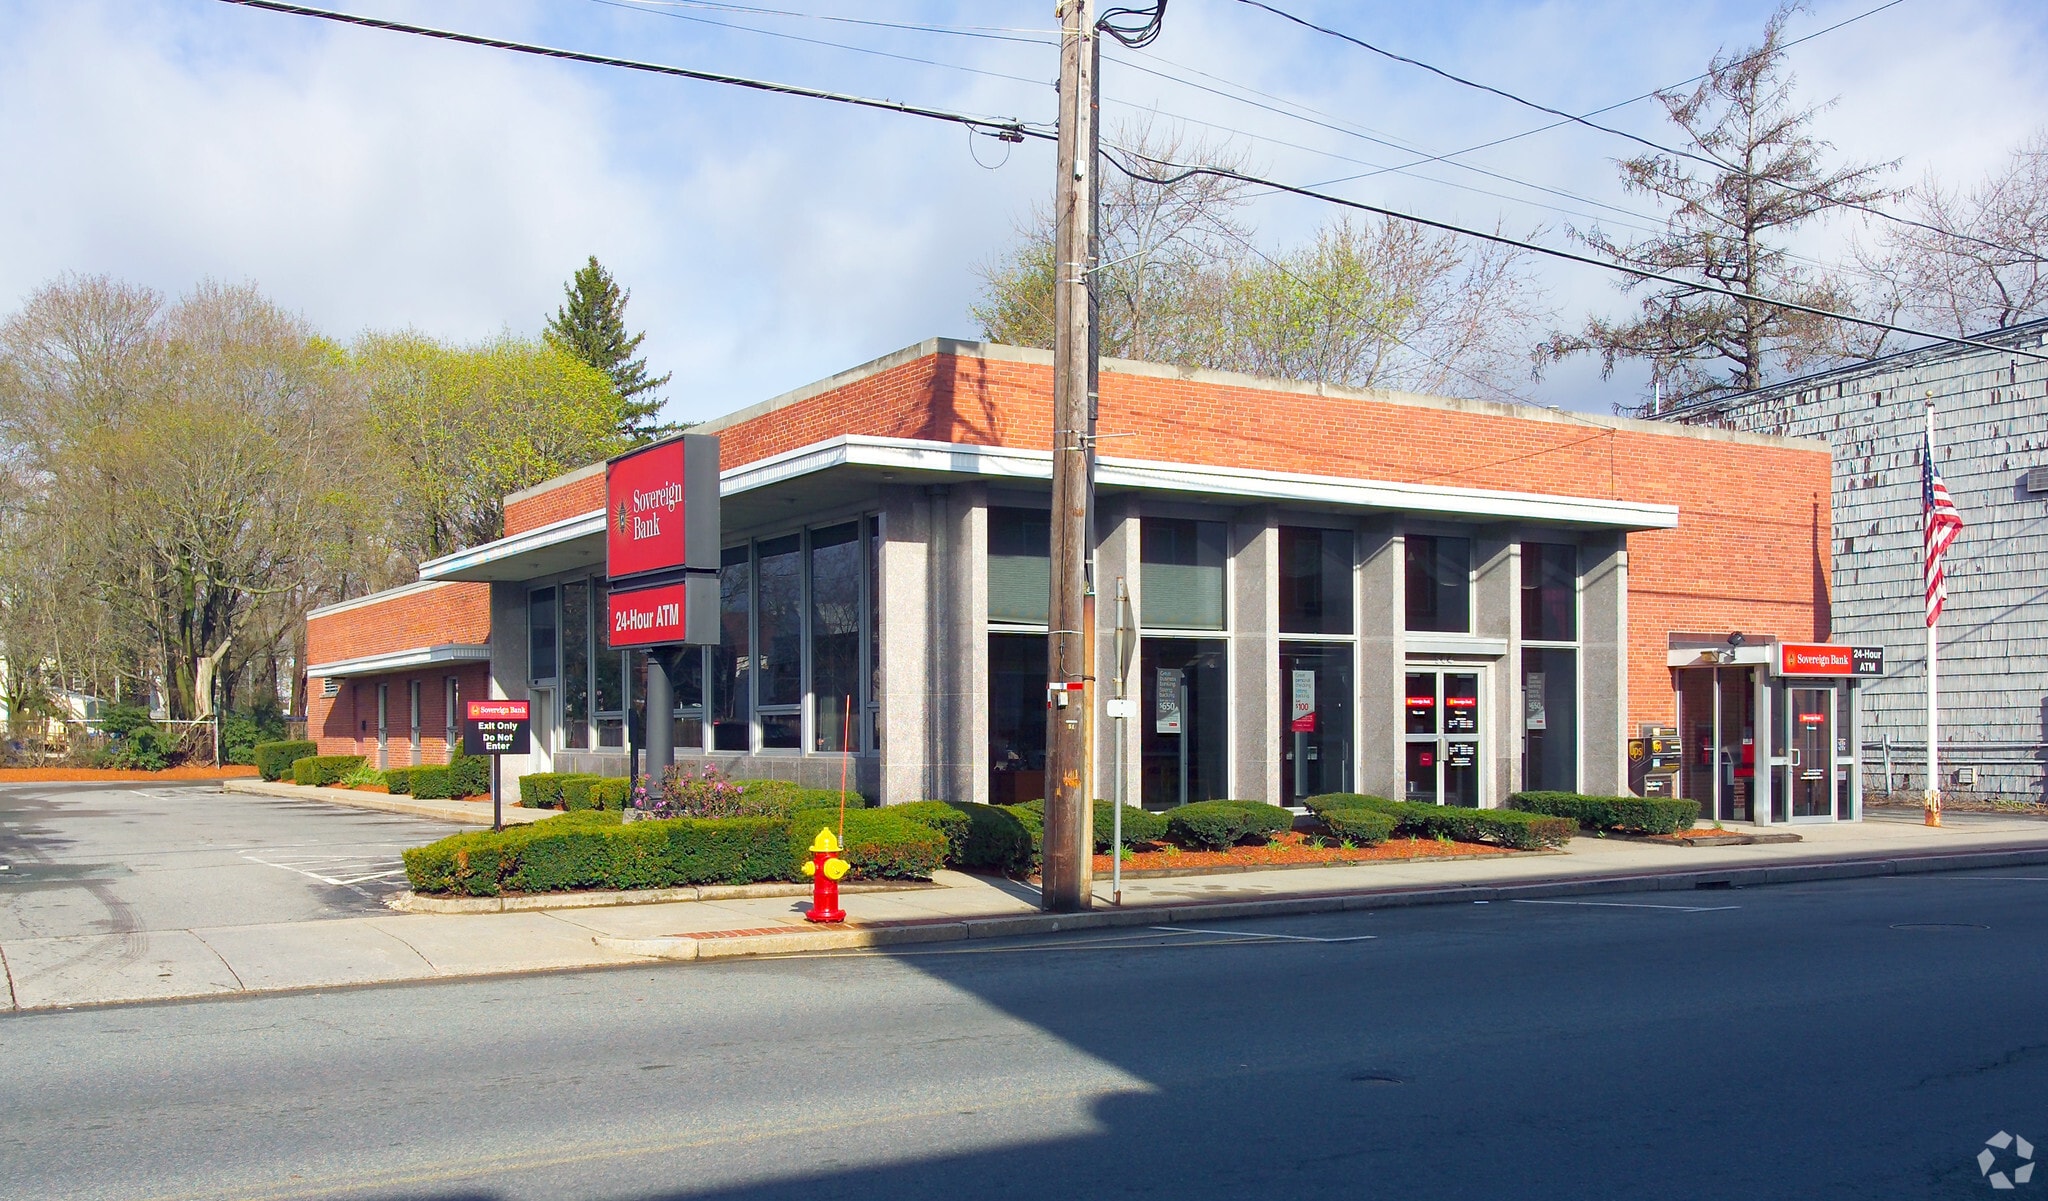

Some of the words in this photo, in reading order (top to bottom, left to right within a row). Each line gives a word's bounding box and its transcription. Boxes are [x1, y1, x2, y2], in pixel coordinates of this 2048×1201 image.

[633, 481, 683, 513] Sovereign
[633, 512, 661, 540] Bank
[615, 608, 654, 632] 24-Hour
[655, 603, 680, 628] ATM
[1853, 649, 1882, 659] 24-Hour
[1797, 653, 1830, 668] Sovereign
[1831, 654, 1849, 665] Bank
[1859, 662, 1876, 672] ATM
[480, 706, 509, 715] Sovereign
[1160, 702, 1175, 710] $650
[478, 722, 496, 730] Exit
[497, 722, 518, 731] Only
[486, 742, 510, 750] Enter
